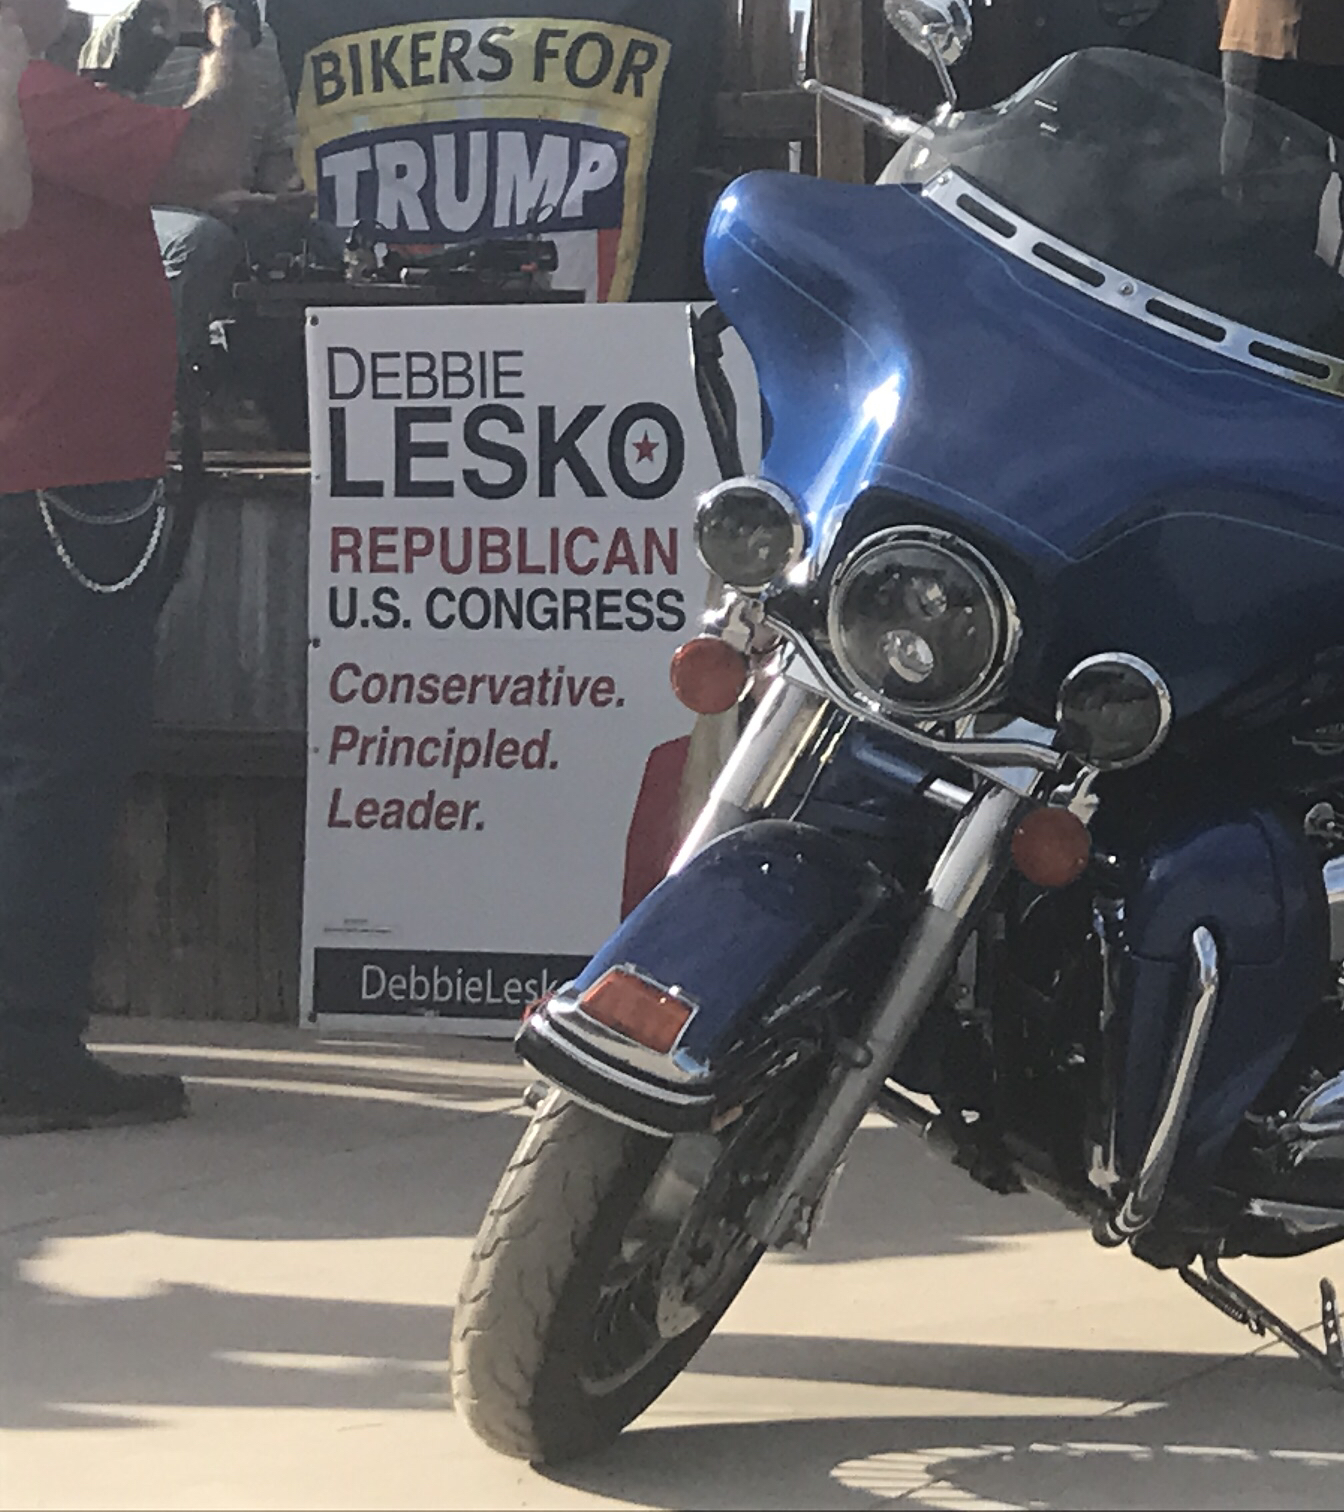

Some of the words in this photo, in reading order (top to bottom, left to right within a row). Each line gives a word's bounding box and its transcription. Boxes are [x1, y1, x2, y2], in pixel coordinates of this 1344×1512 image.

[311, 26, 514, 106] BIKERS
[533, 27, 659, 98] FOR
[321, 130, 618, 233] TRUMP
[327, 346, 525, 400] DEBBIE
[329, 402, 686, 500] LESKO
[330, 526, 679, 576] REPUBLICAN
[329, 586, 411, 629] U.S.
[426, 586, 687, 632] CONGRESS
[329, 662, 627, 708] Conservative.
[328, 724, 559, 778] Principled.
[327, 788, 485, 832] Leader.
[361, 964, 560, 1005] DebbieLesk
